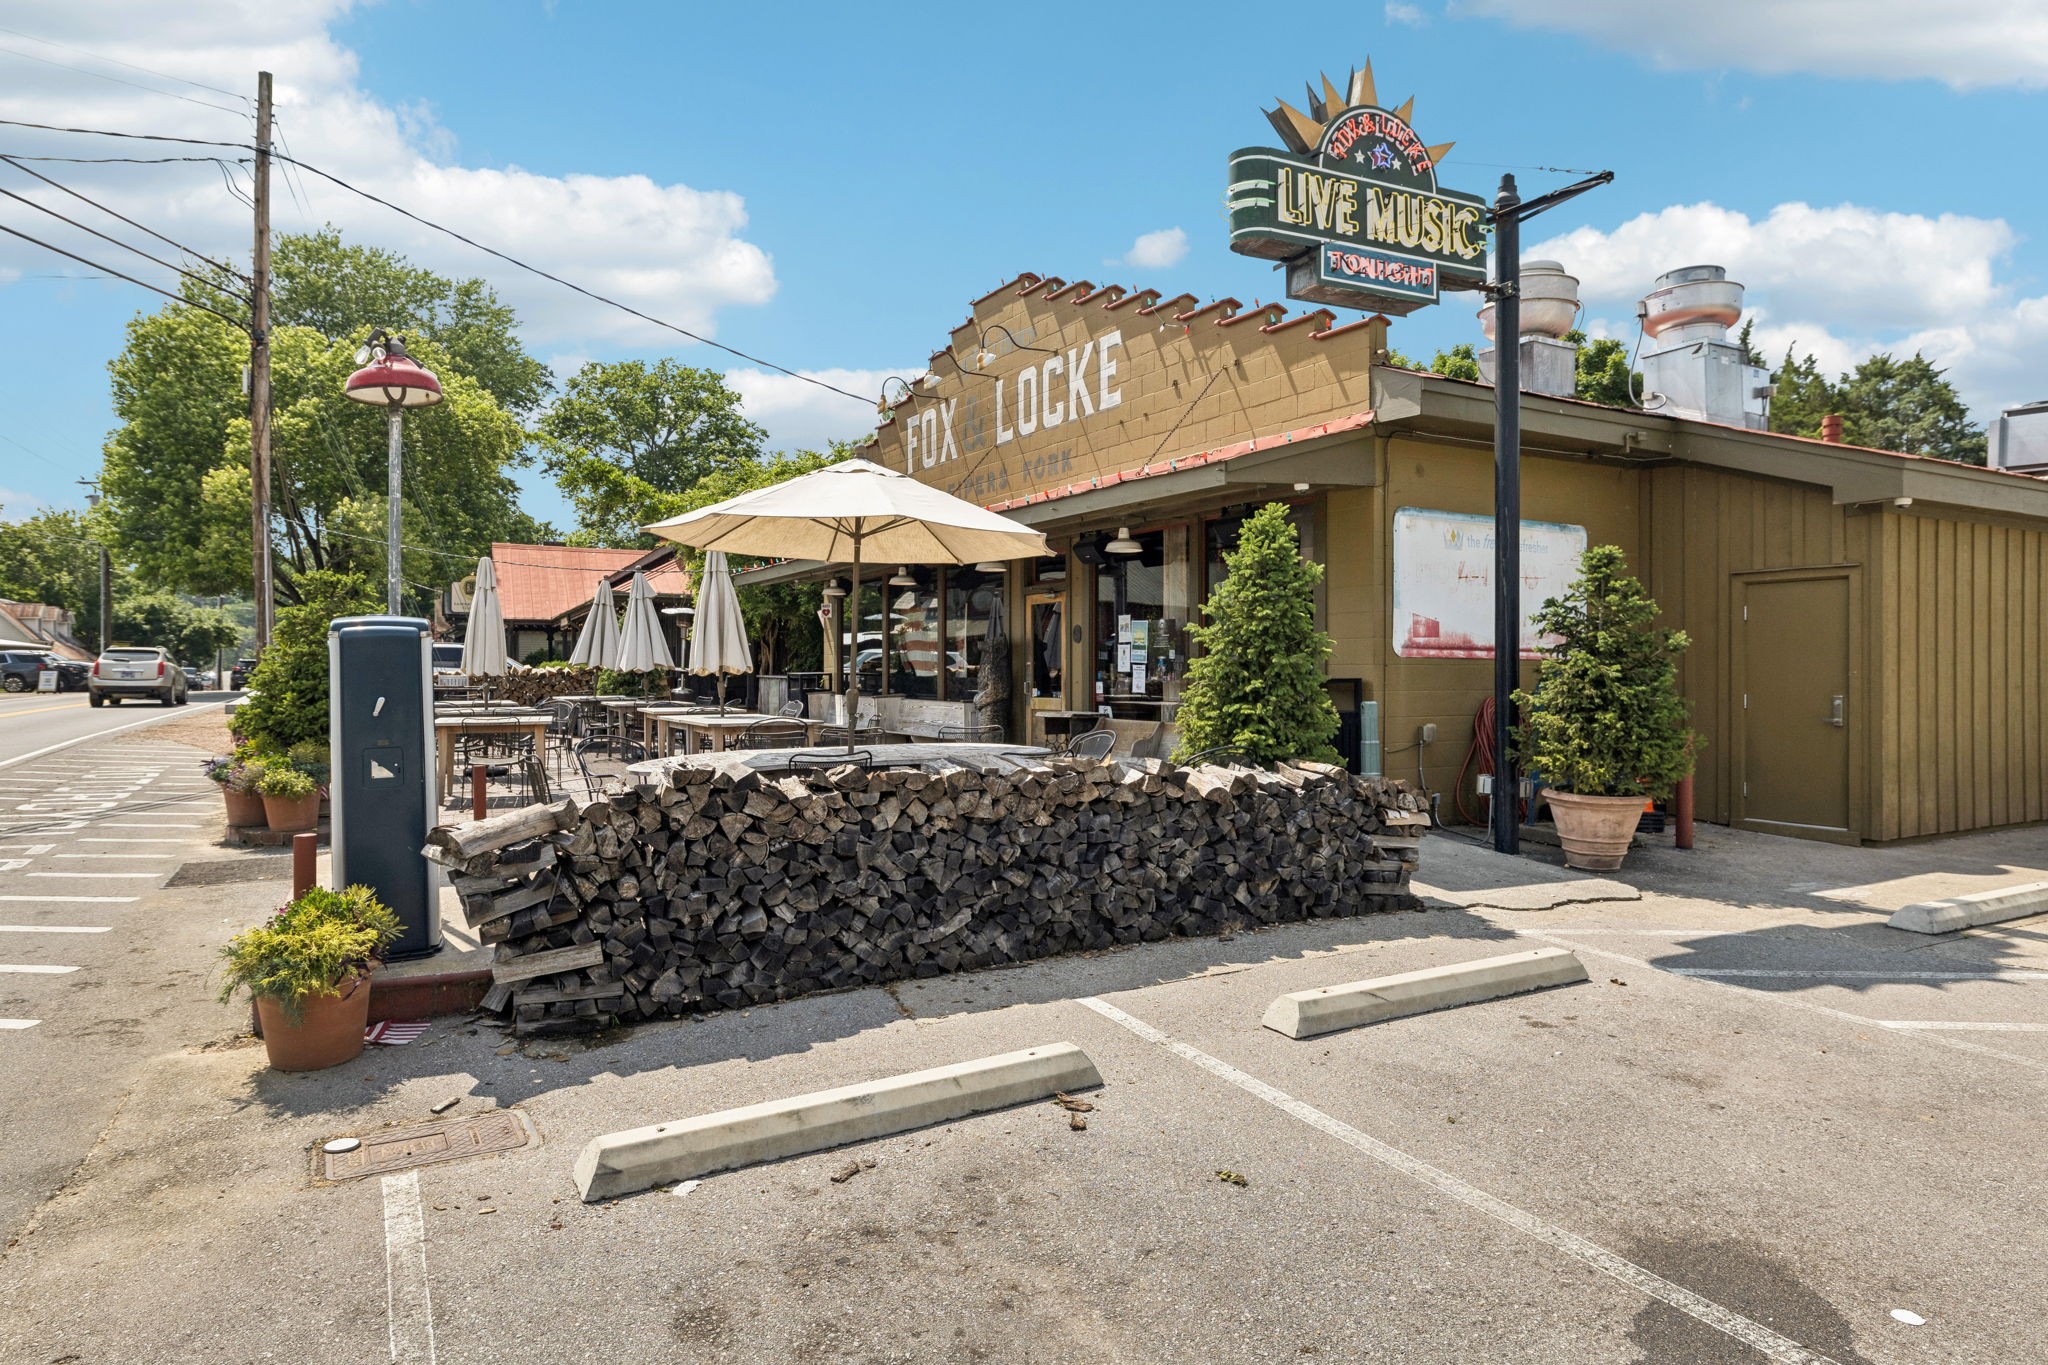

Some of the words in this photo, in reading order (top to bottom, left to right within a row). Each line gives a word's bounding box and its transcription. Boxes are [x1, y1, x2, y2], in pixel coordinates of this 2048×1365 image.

[1375, 113, 1433, 177] LOCKE
[1278, 168, 1359, 236] LIVE
[1366, 187, 1480, 260] MUSIC
[1327, 251, 1435, 289] TONIGHT
[907, 398, 958, 476] FOX
[996, 330, 1122, 447] LOCKE
[1023, 447, 1073, 482] FORK
[1467, 534, 1480, 549] the
